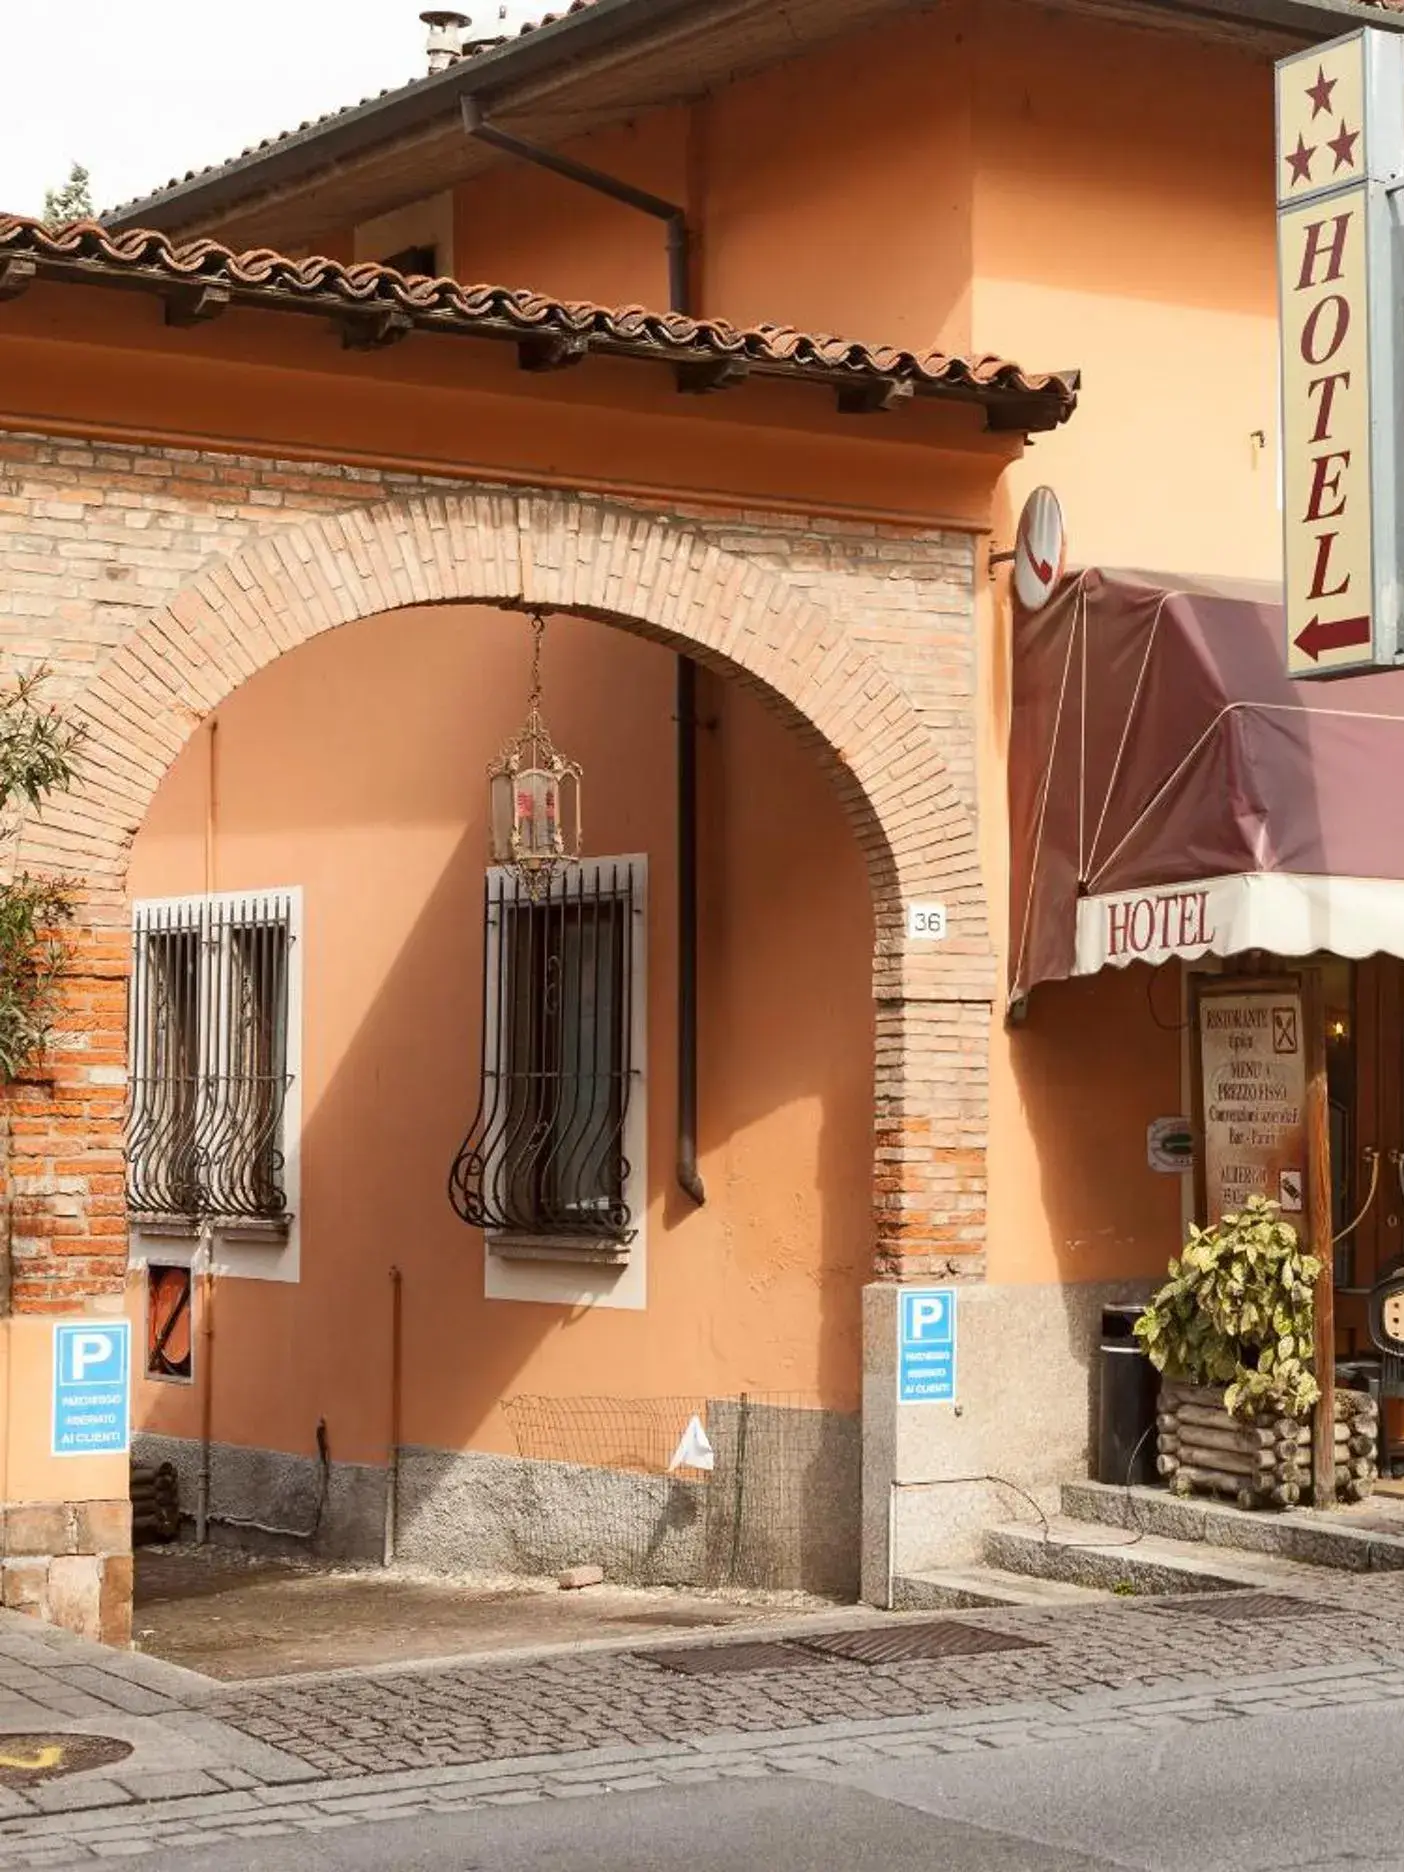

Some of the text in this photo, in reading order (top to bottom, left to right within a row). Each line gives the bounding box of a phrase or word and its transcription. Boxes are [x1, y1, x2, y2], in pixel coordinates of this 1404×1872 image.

[1293, 211, 1353, 600] HOTEL
[915, 912, 941, 932] 36
[1107, 890, 1216, 956] HOTEL
[912, 1298, 944, 1340] P
[71, 1333, 113, 1380] P
